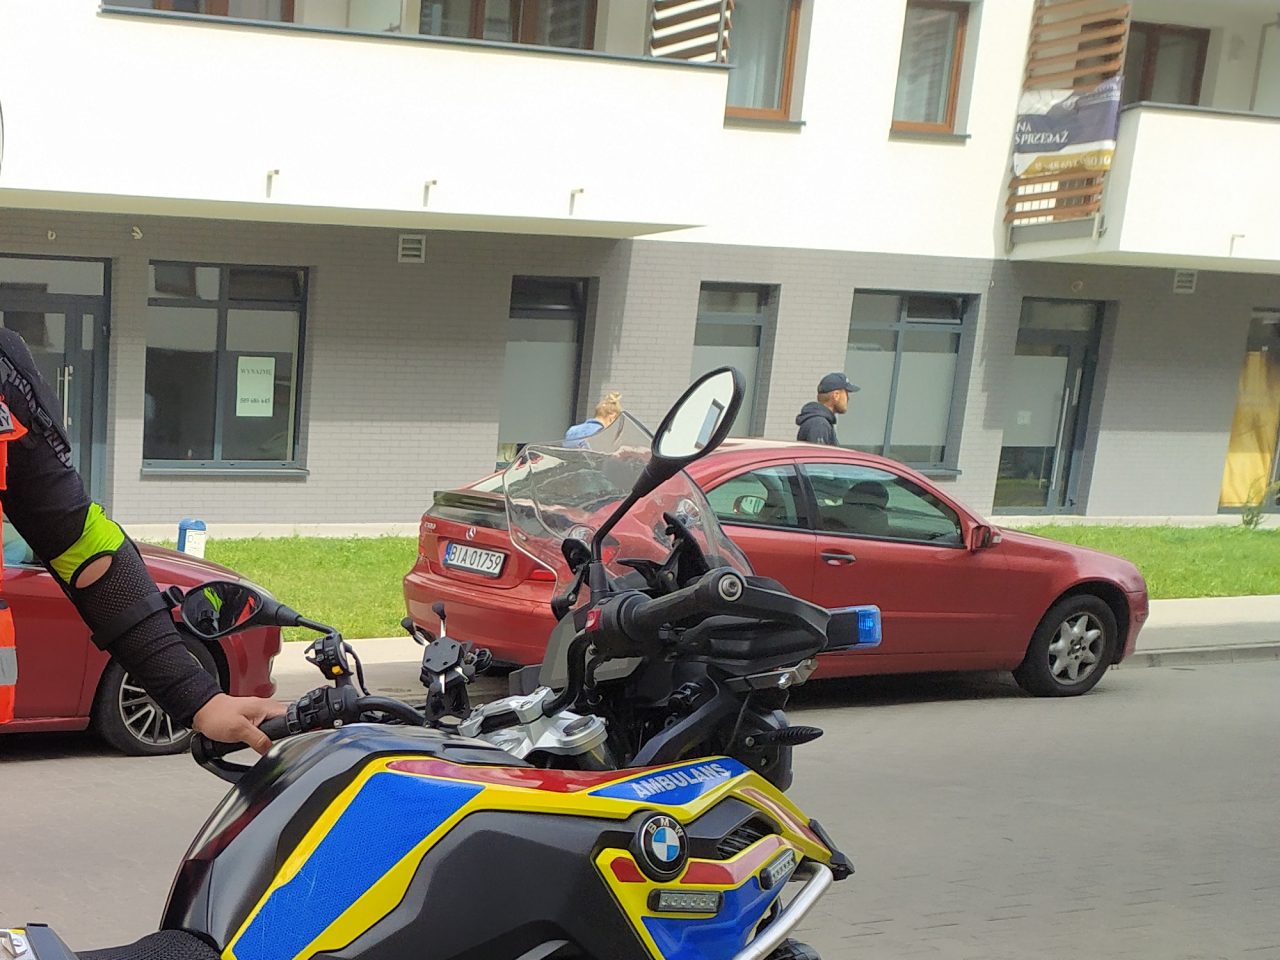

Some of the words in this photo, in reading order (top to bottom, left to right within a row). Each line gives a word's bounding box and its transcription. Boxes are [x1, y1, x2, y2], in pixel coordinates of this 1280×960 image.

[1015, 121, 1032, 133] NA
[450, 546, 469, 565] BIA
[469, 550, 502, 572] 01759
[631, 763, 732, 799] AMBULANS
[647, 817, 685, 836] BMW
